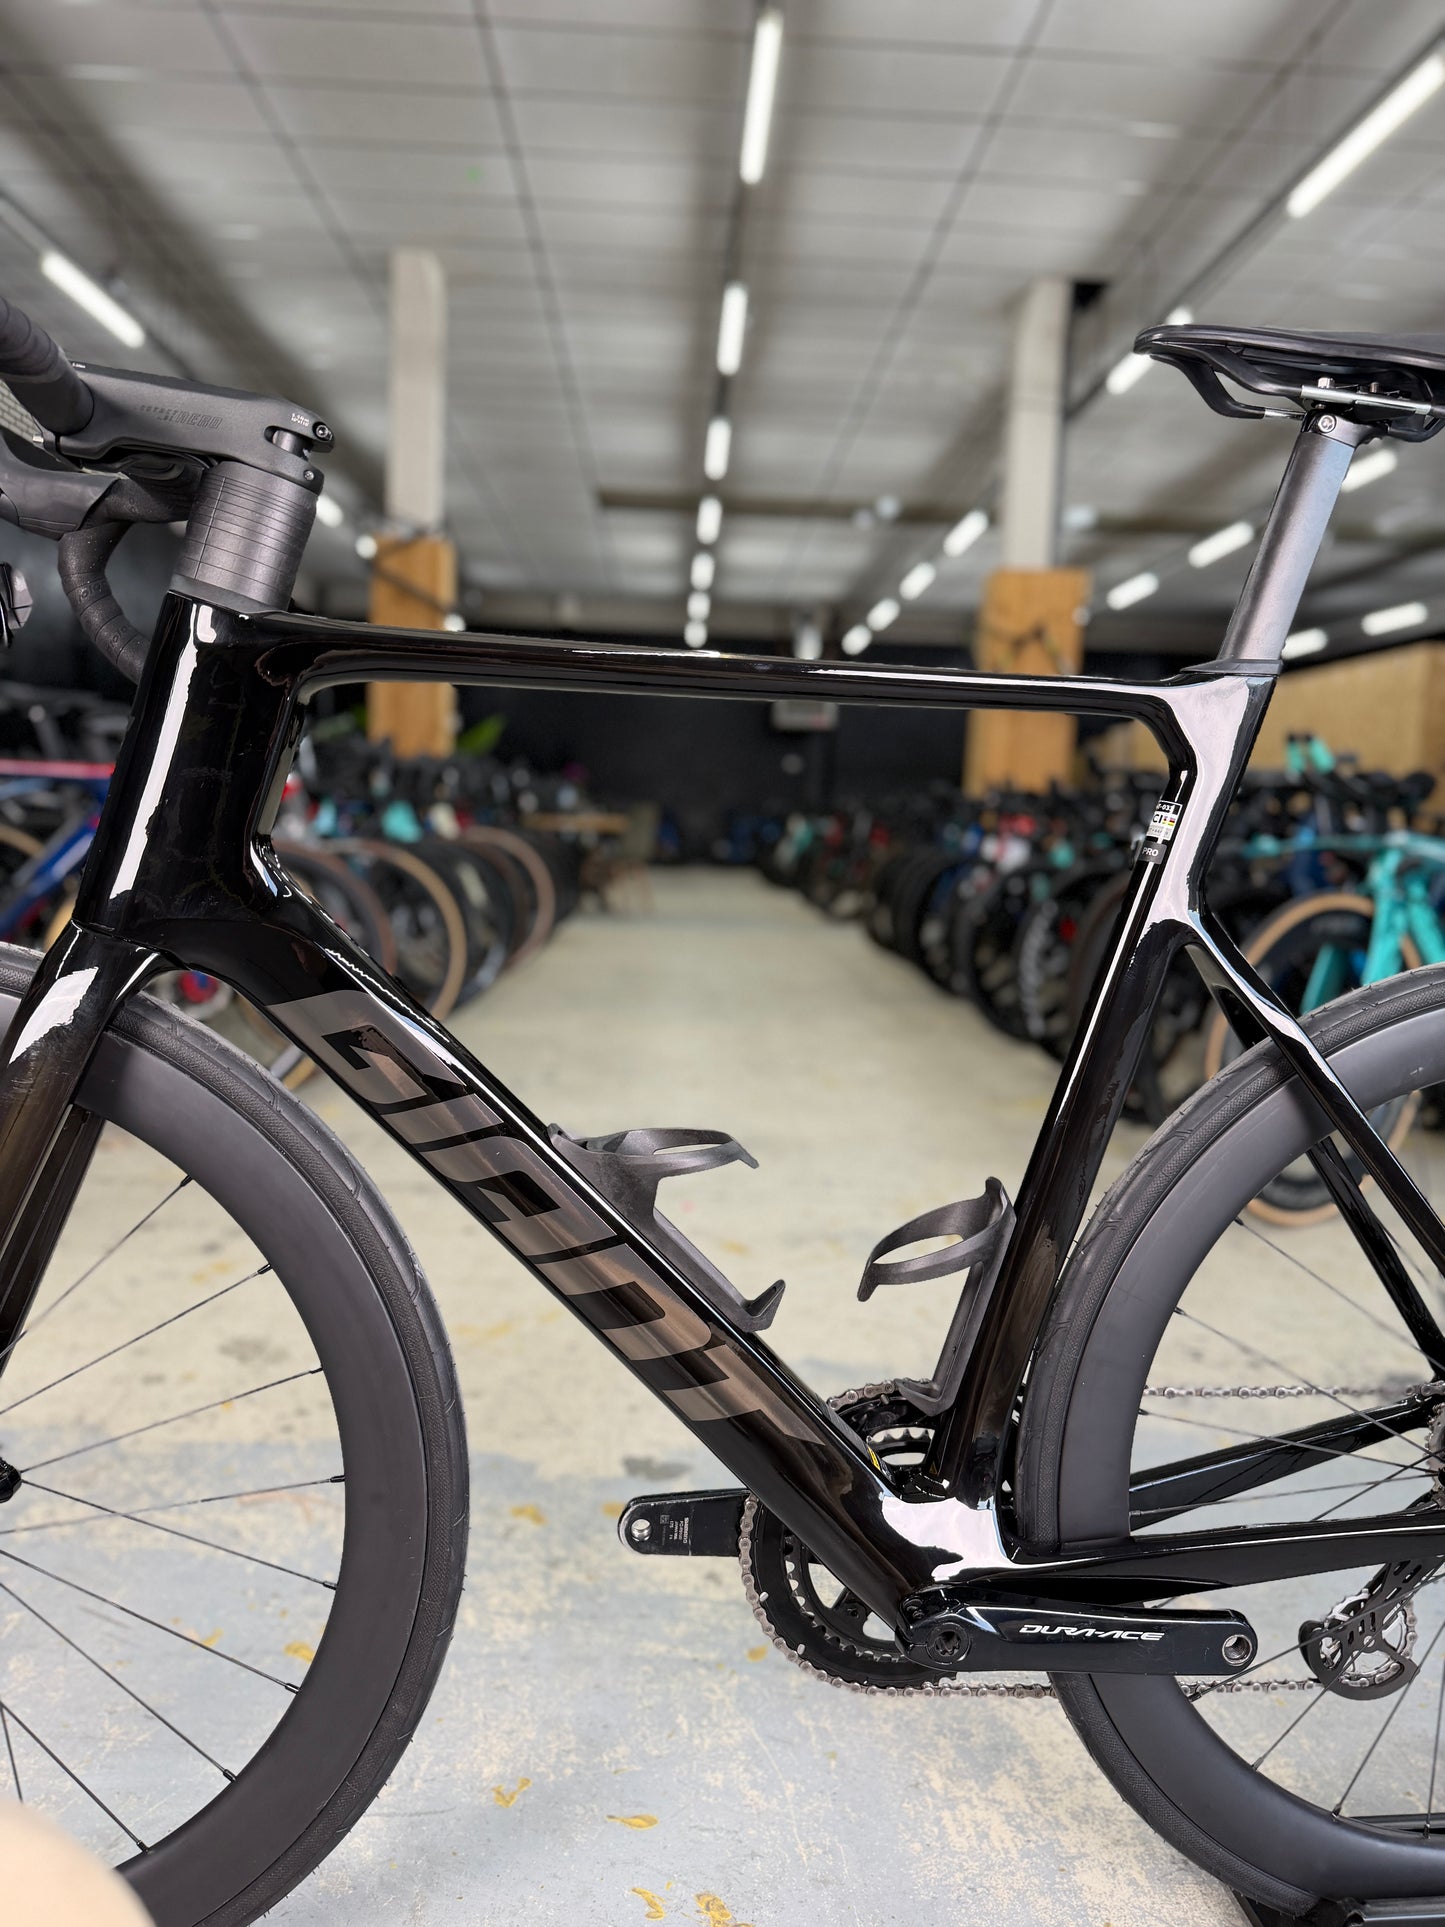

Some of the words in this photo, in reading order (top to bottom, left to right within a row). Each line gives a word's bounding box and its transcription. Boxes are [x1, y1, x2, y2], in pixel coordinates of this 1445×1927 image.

[1141, 846, 1159, 857] PRO
[267, 989, 825, 1445] GIANT
[1019, 1624, 1165, 1641] DURA-ACE
